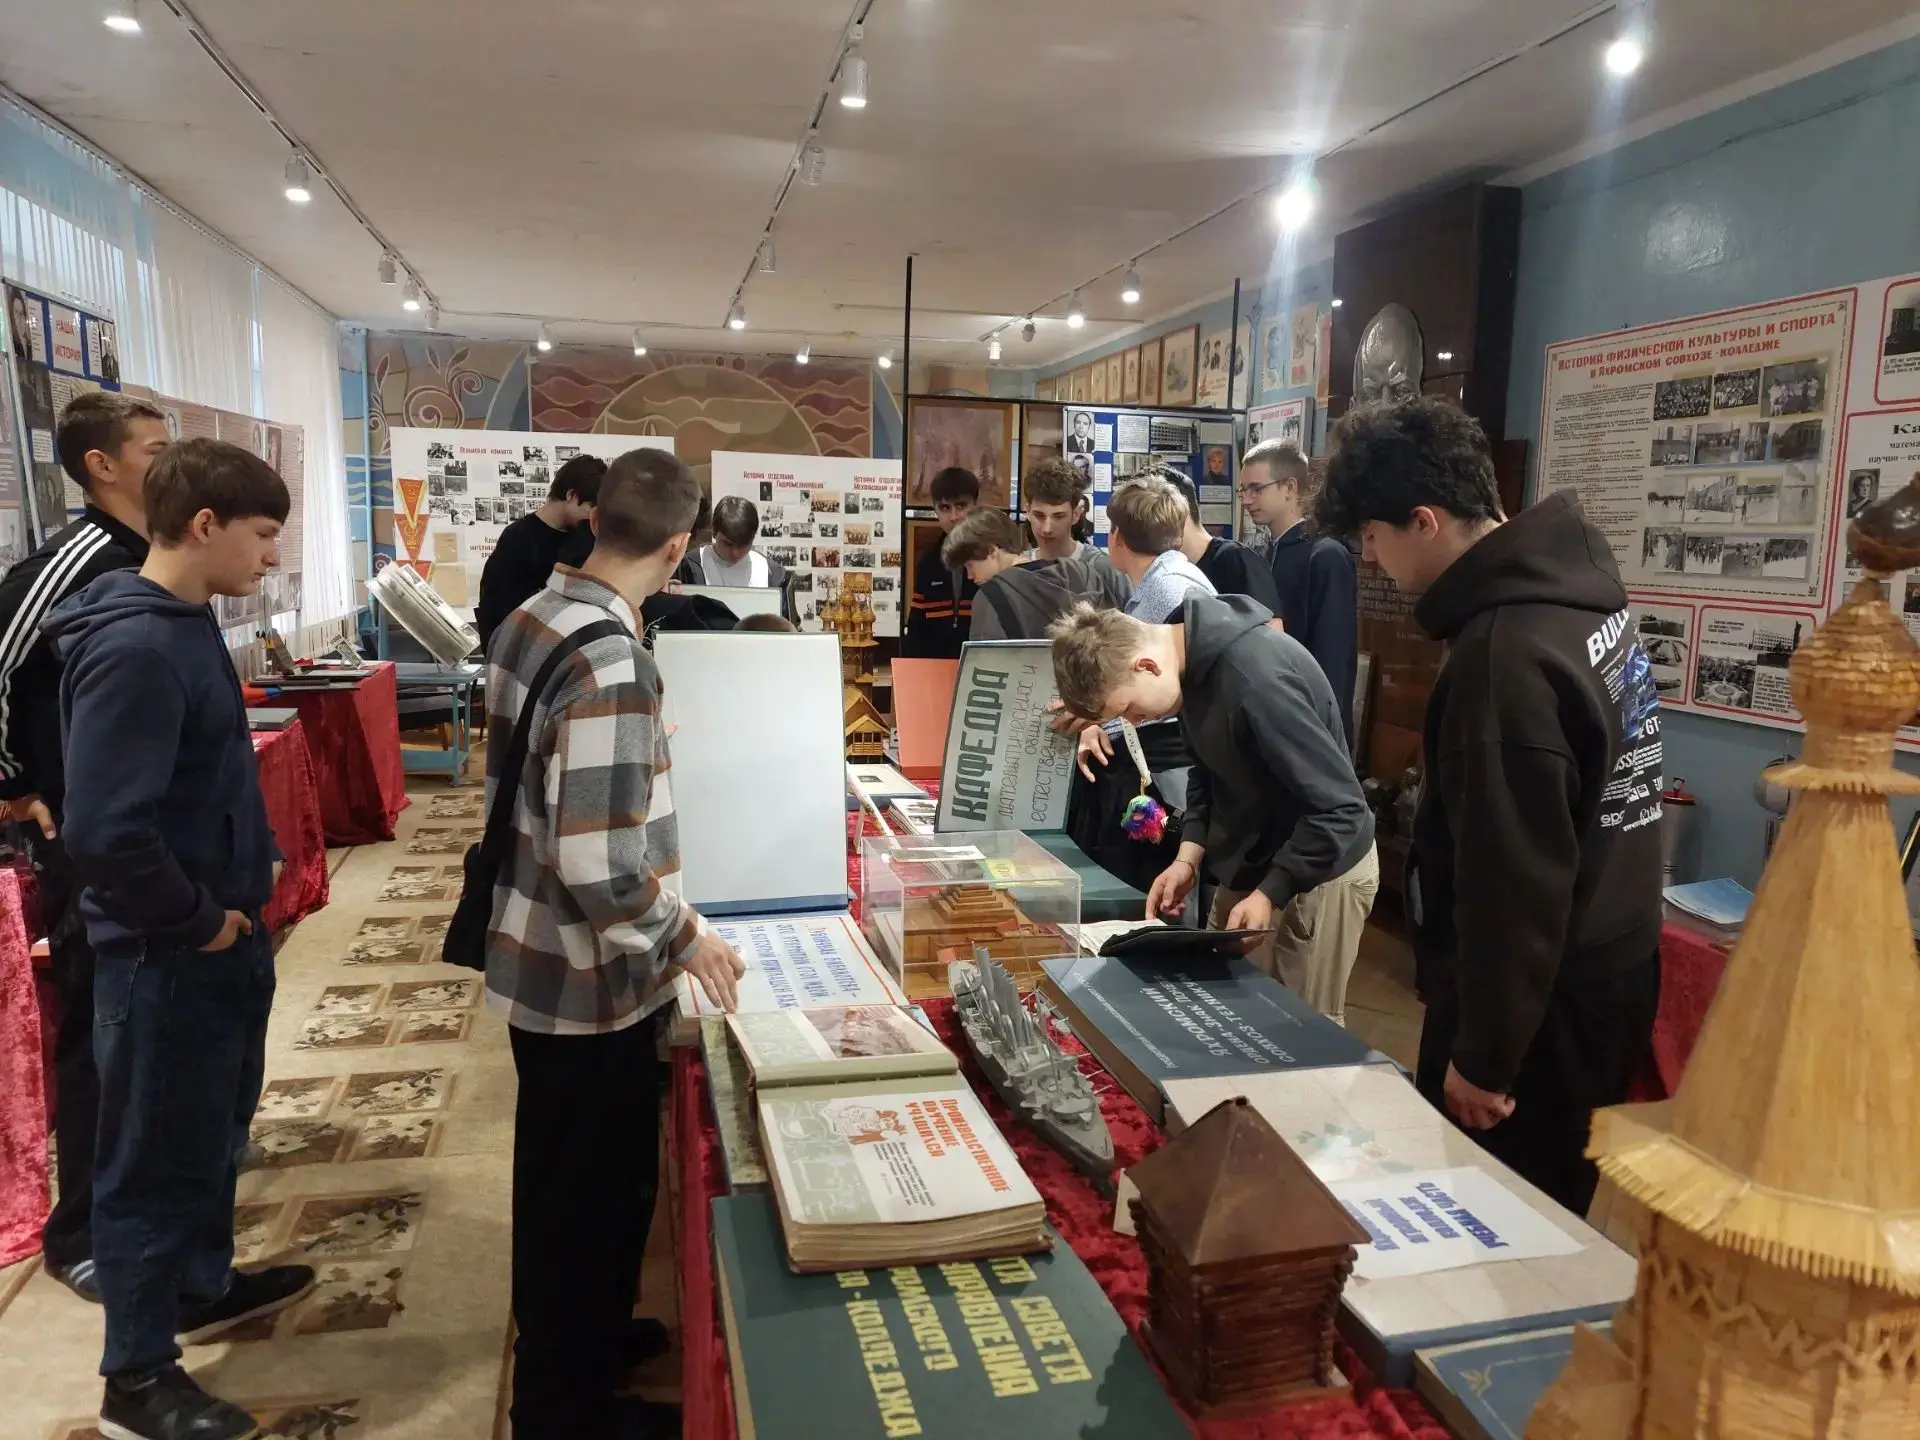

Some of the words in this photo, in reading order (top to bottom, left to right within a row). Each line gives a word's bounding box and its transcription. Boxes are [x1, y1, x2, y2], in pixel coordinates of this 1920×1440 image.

[1558, 353, 1604, 371] ИСТОРИЯ
[1606, 338, 1684, 363] ФИЗИЧЕСКОЙ
[1688, 325, 1761, 349] КУЛЬТУРЫ
[1765, 322, 1776, 336] И
[1779, 312, 1836, 334] СПОРТА
[1598, 360, 1661, 378] ЯХРОМСКОМ
[951, 666, 1010, 822] КАФЕДРА
[1138, 986, 1233, 1057] ЯХРОМСКИЙ
[905, 1101, 947, 1159] УЧАЩИХСЯ
[922, 1099, 962, 1149] ОБУЧЕНИЕ
[937, 1097, 1013, 1194] ПРОИЗВОДСТВЕННОЕ
[1415, 1181, 1457, 1209] ЧАСТЬ
[1445, 1207, 1509, 1249] УЧЕБНАЯ
[1010, 1295, 1093, 1385] СОВЕТА
